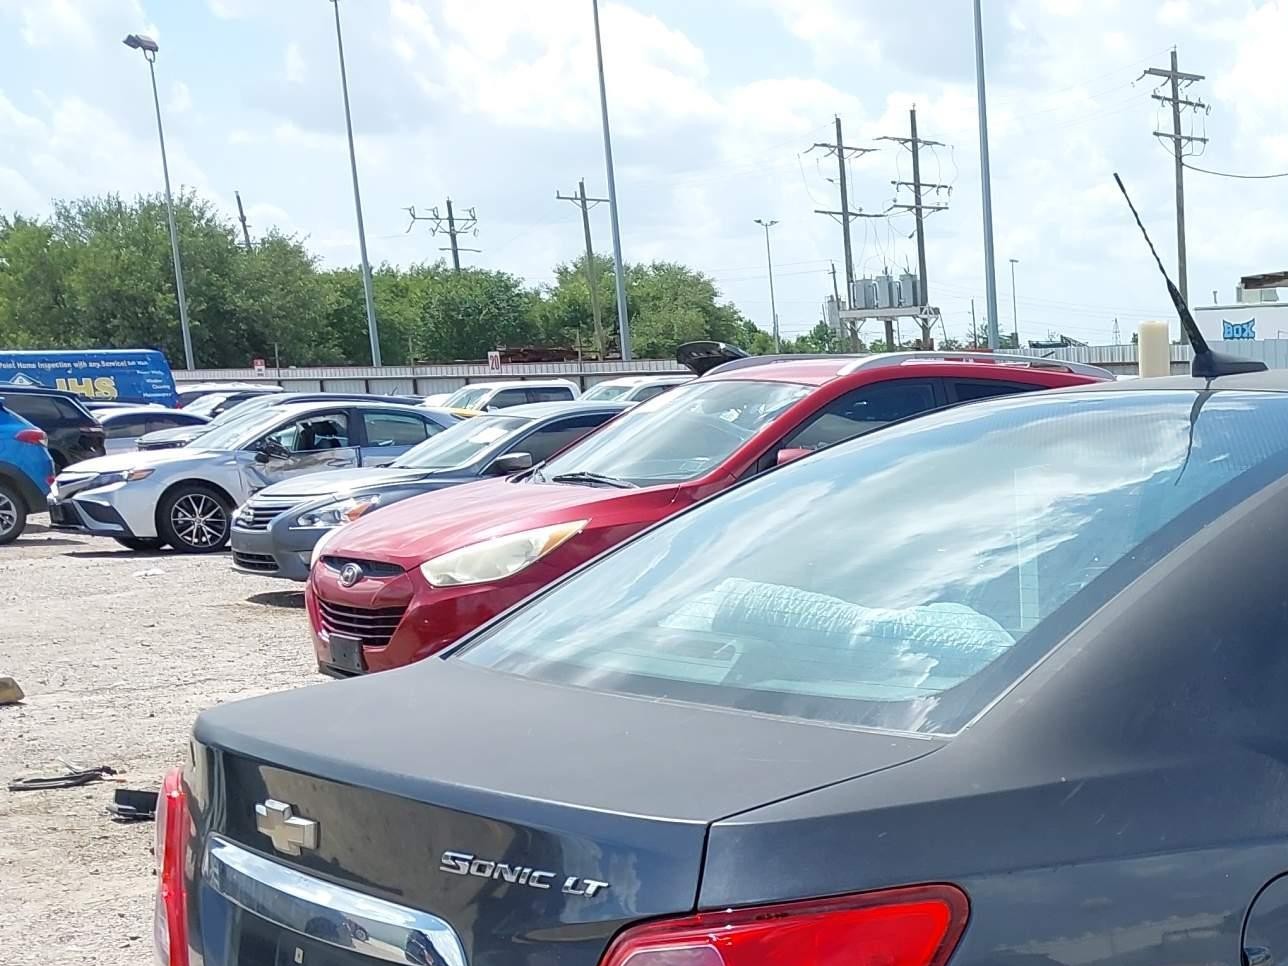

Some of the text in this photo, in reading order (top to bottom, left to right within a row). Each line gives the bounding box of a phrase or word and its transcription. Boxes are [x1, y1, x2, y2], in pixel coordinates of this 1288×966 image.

[1222, 318, 1256, 340] BOX
[16, 361, 37, 369] Home
[38, 361, 72, 371] Inspection
[73, 361, 88, 369] with
[490, 354, 500, 370] 20
[440, 851, 609, 898] SONIC LT
